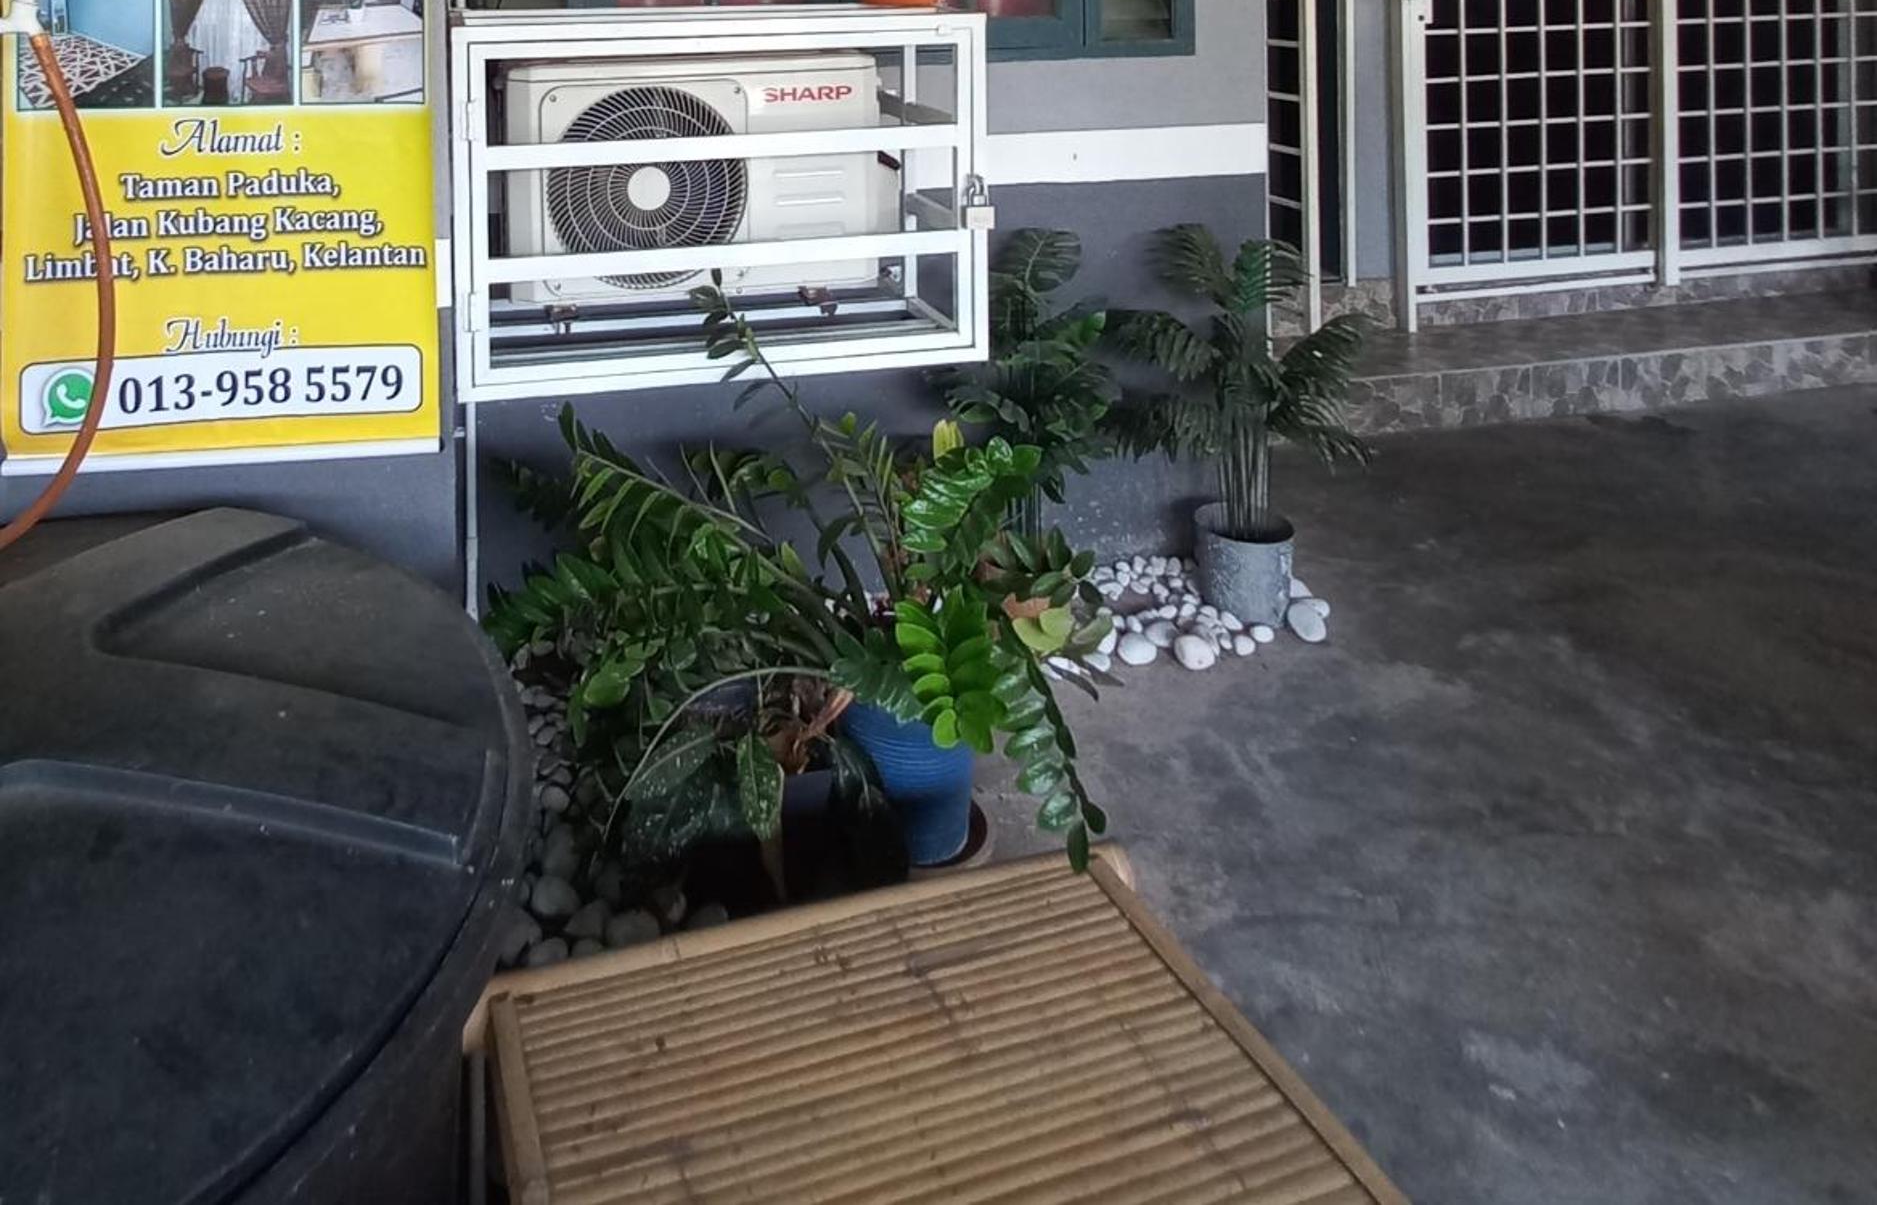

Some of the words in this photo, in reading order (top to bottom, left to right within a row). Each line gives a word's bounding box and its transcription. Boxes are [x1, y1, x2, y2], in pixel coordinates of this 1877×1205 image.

[762, 85, 852, 103] SHARP
[161, 119, 282, 155] Alamat
[120, 173, 218, 199] Taman
[225, 168, 341, 197] Paduka,
[157, 210, 266, 240] Kubang
[274, 207, 383, 235] Kacang,
[147, 249, 176, 275] K.
[184, 246, 295, 275] Baharu,
[303, 242, 426, 269] Kelantan
[166, 318, 280, 359] Hubungi
[118, 367, 293, 414] 013-958
[304, 363, 404, 403] 5579
